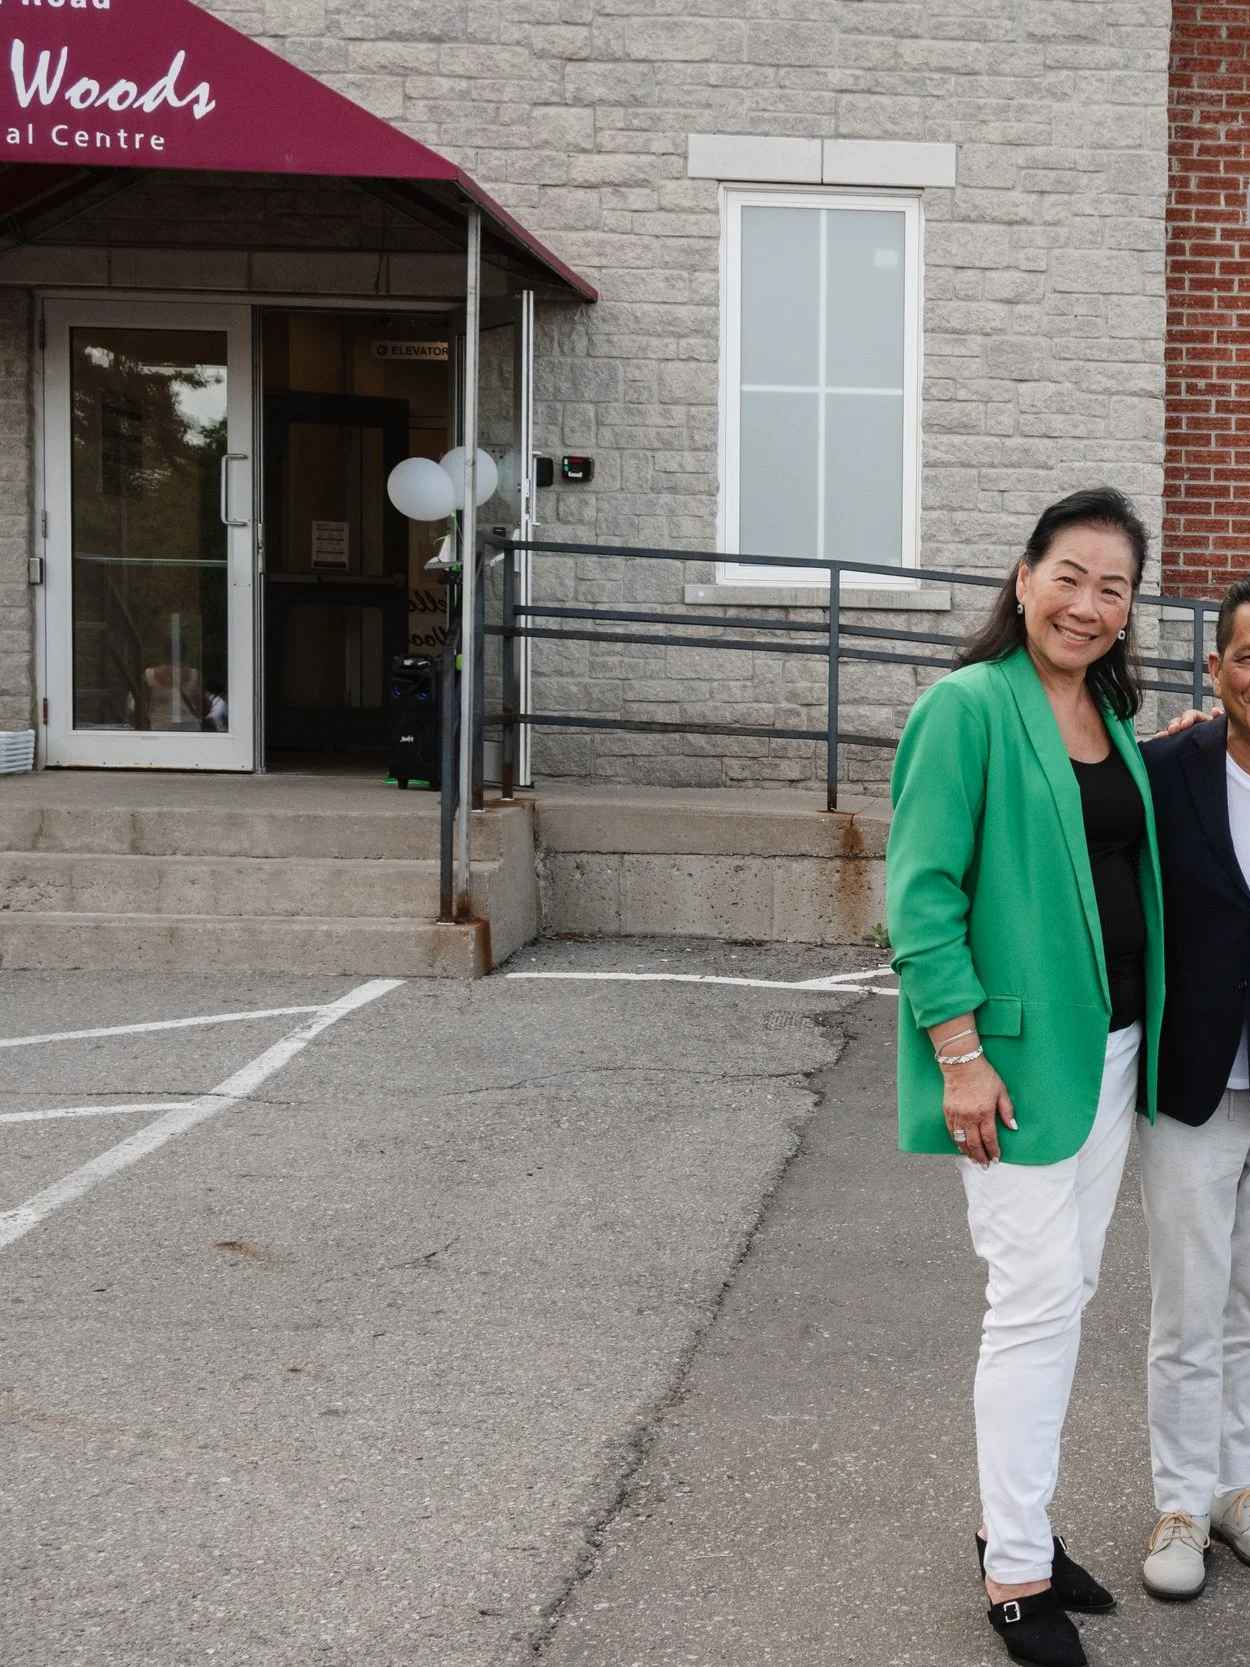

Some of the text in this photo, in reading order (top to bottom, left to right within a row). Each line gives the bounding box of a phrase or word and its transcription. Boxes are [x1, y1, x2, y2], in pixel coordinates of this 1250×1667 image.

[10, 38, 216, 120] Woods
[51, 124, 166, 151] Centre
[391, 345, 449, 356] ELEVATOR
